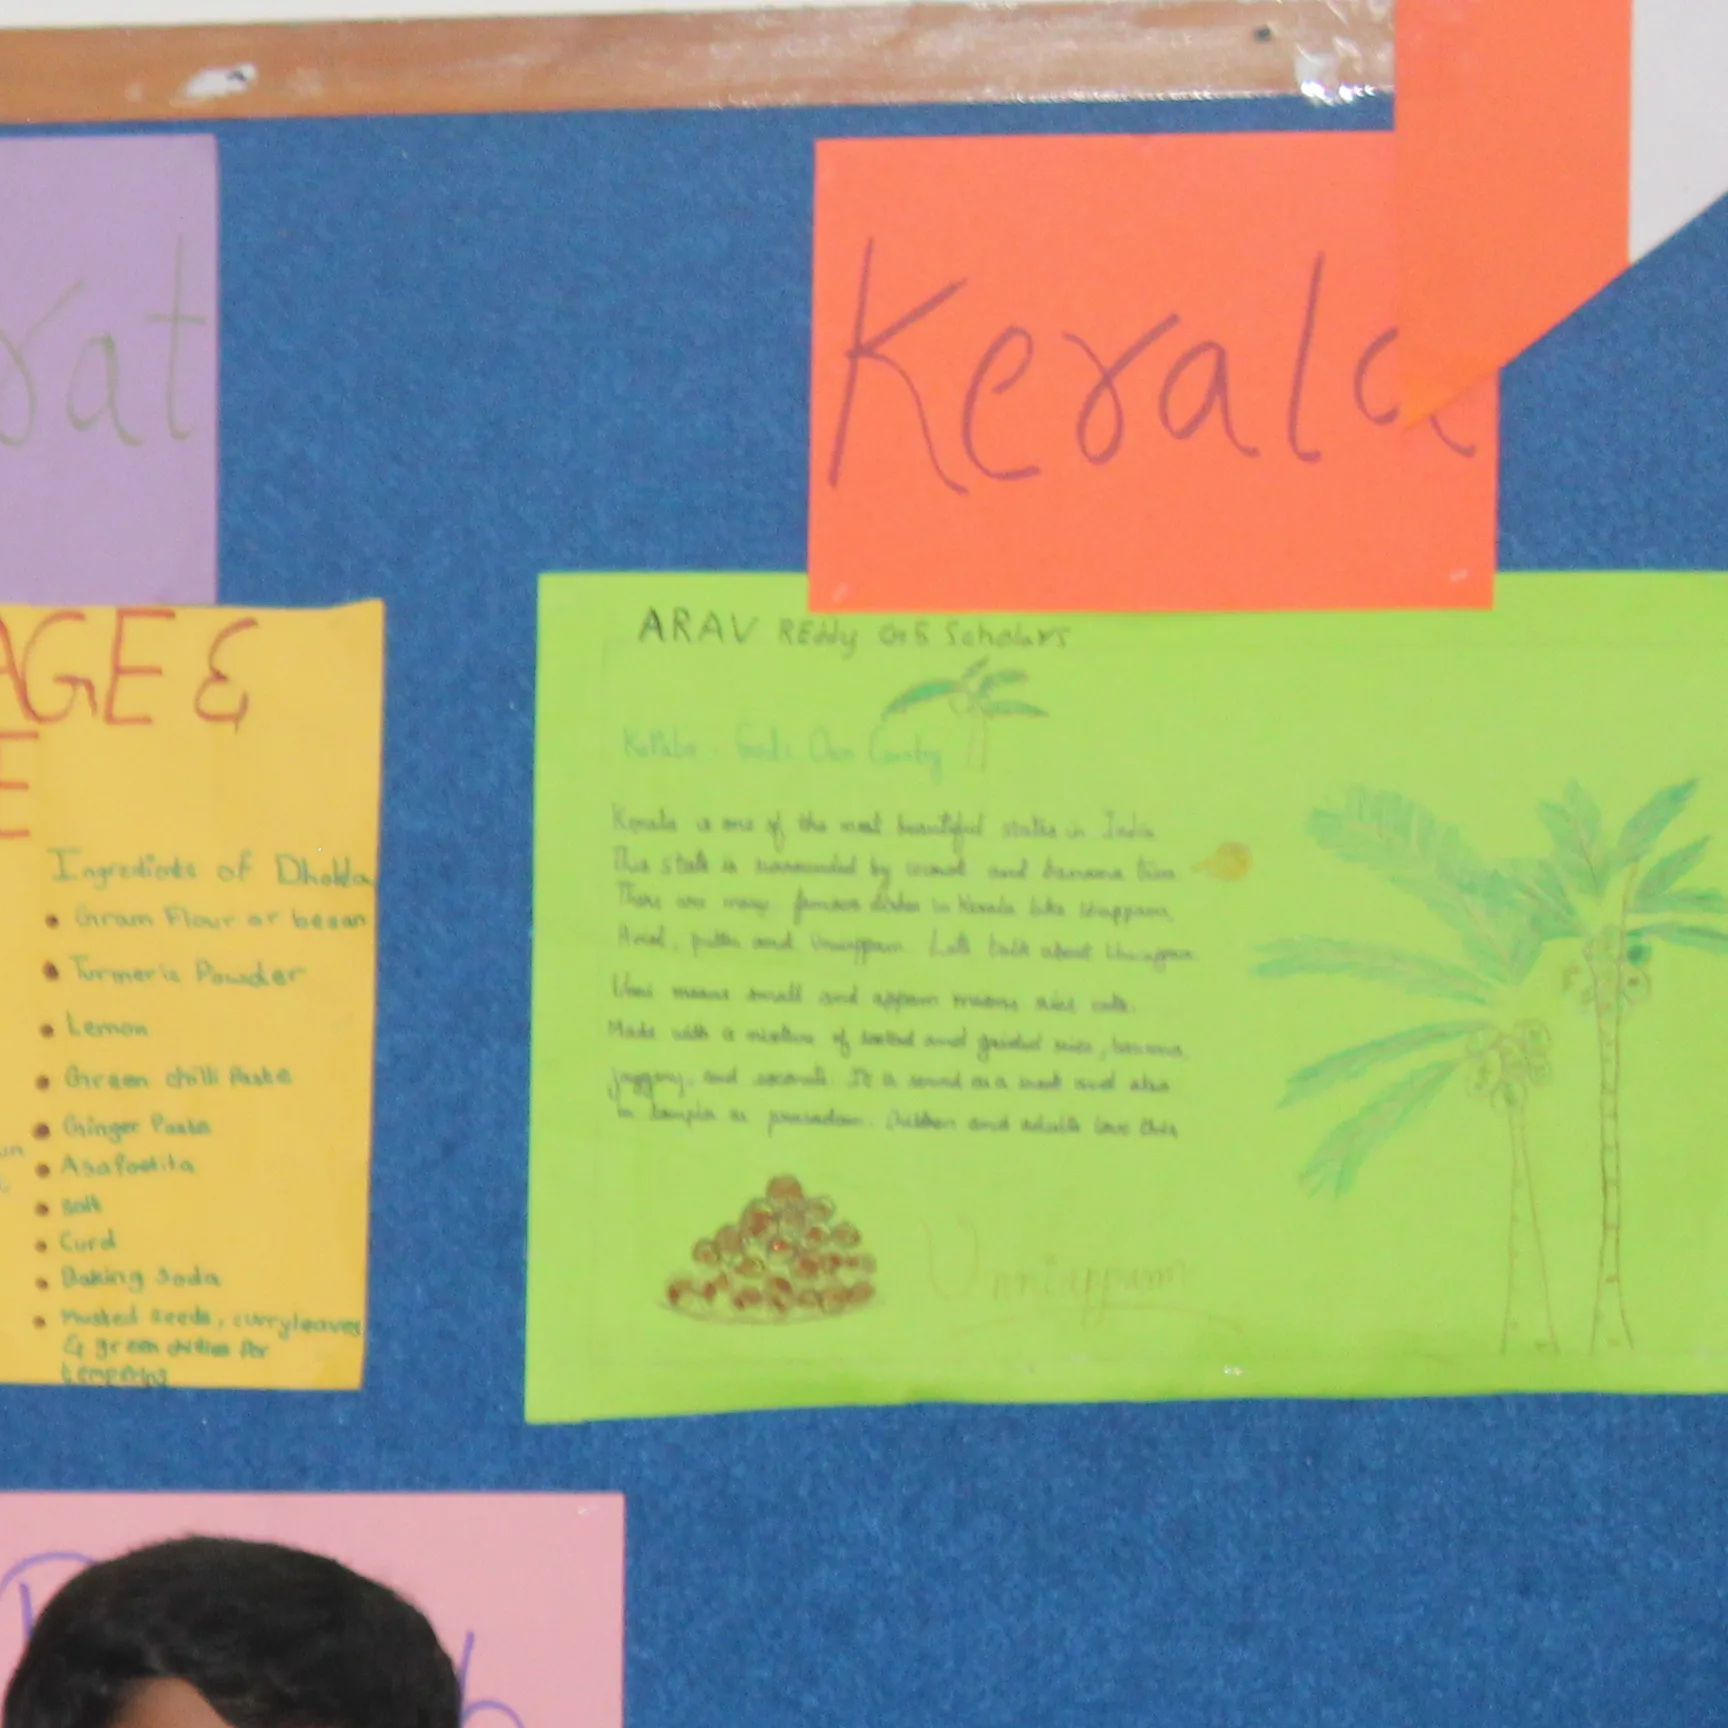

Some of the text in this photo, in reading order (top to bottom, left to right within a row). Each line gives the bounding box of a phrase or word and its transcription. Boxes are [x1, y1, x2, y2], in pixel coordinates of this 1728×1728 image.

[638, 606, 758, 645] ARAV
[193, 617, 259, 733] &
[217, 850, 255, 883] of
[66, 1010, 149, 1036] Lemon
[60, 1228, 117, 1252] Curd
